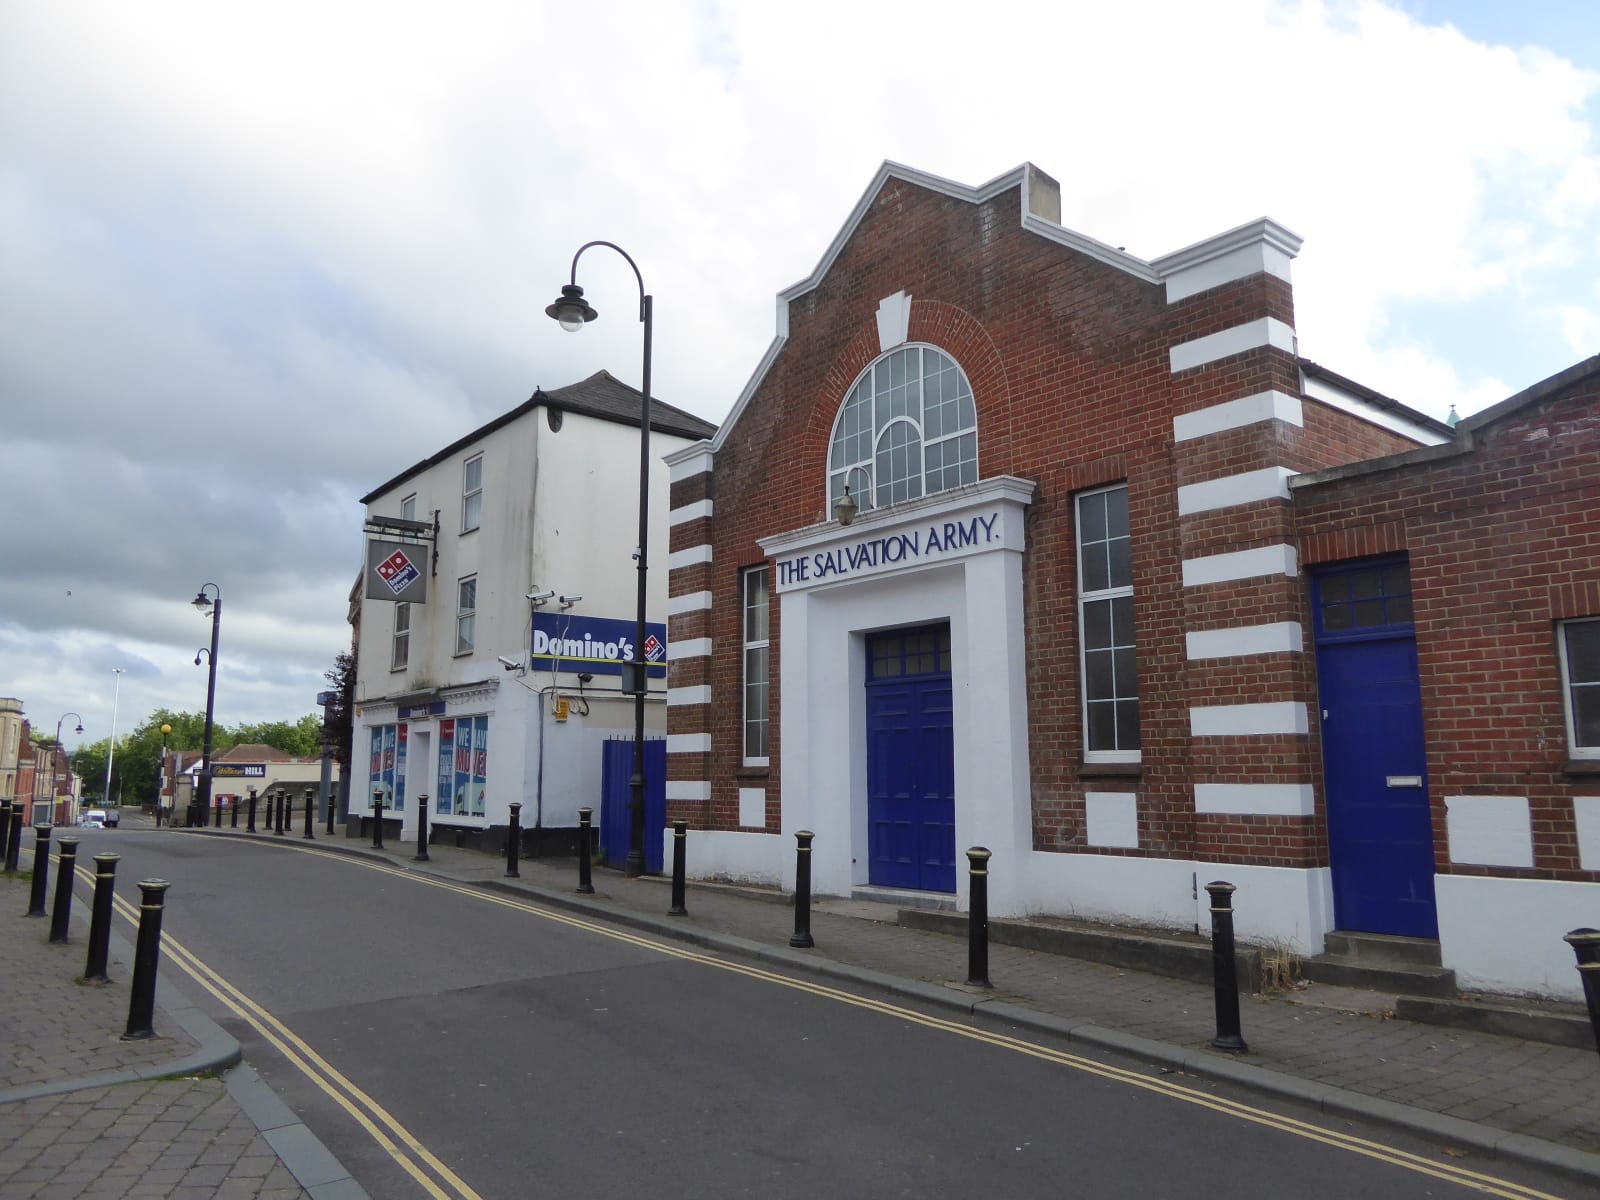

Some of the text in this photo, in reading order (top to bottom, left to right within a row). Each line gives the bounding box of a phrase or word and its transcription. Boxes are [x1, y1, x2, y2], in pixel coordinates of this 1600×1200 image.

[777, 556, 809, 585] THE
[813, 531, 919, 578] SALVATION
[533, 629, 634, 661] Domino's
[457, 726, 470, 747] WE
[245, 766, 264, 775] HILL
